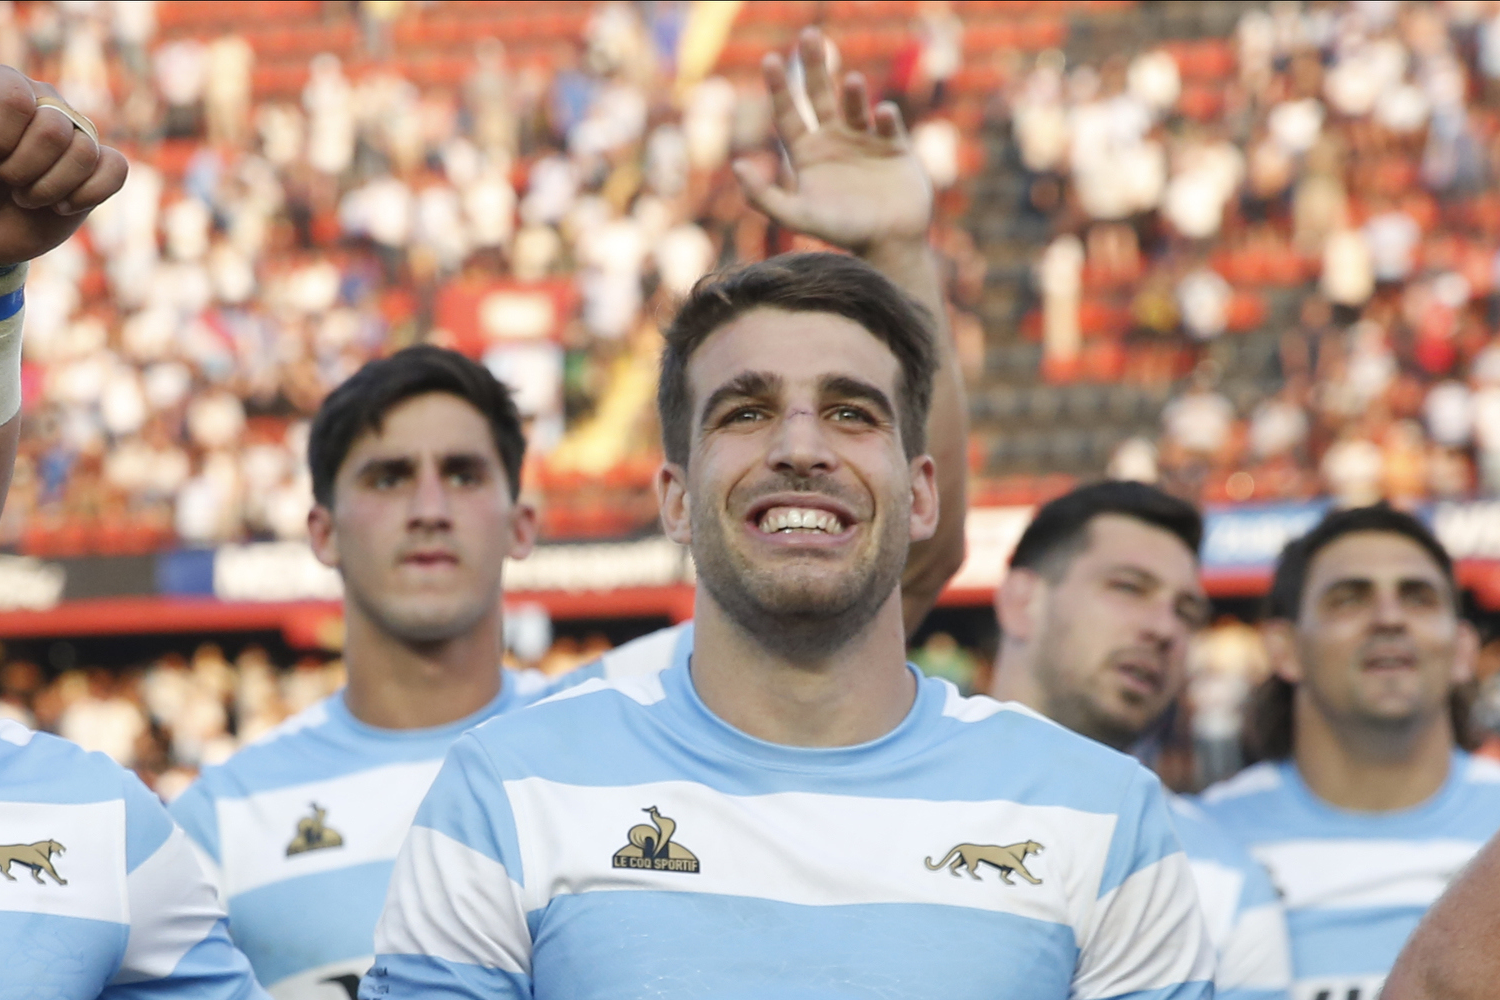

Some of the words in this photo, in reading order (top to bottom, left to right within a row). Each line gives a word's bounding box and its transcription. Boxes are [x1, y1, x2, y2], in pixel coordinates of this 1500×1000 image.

[614, 857, 628, 867] LE
[630, 858, 652, 869] COQ
[654, 858, 698, 872] SPORTIF
